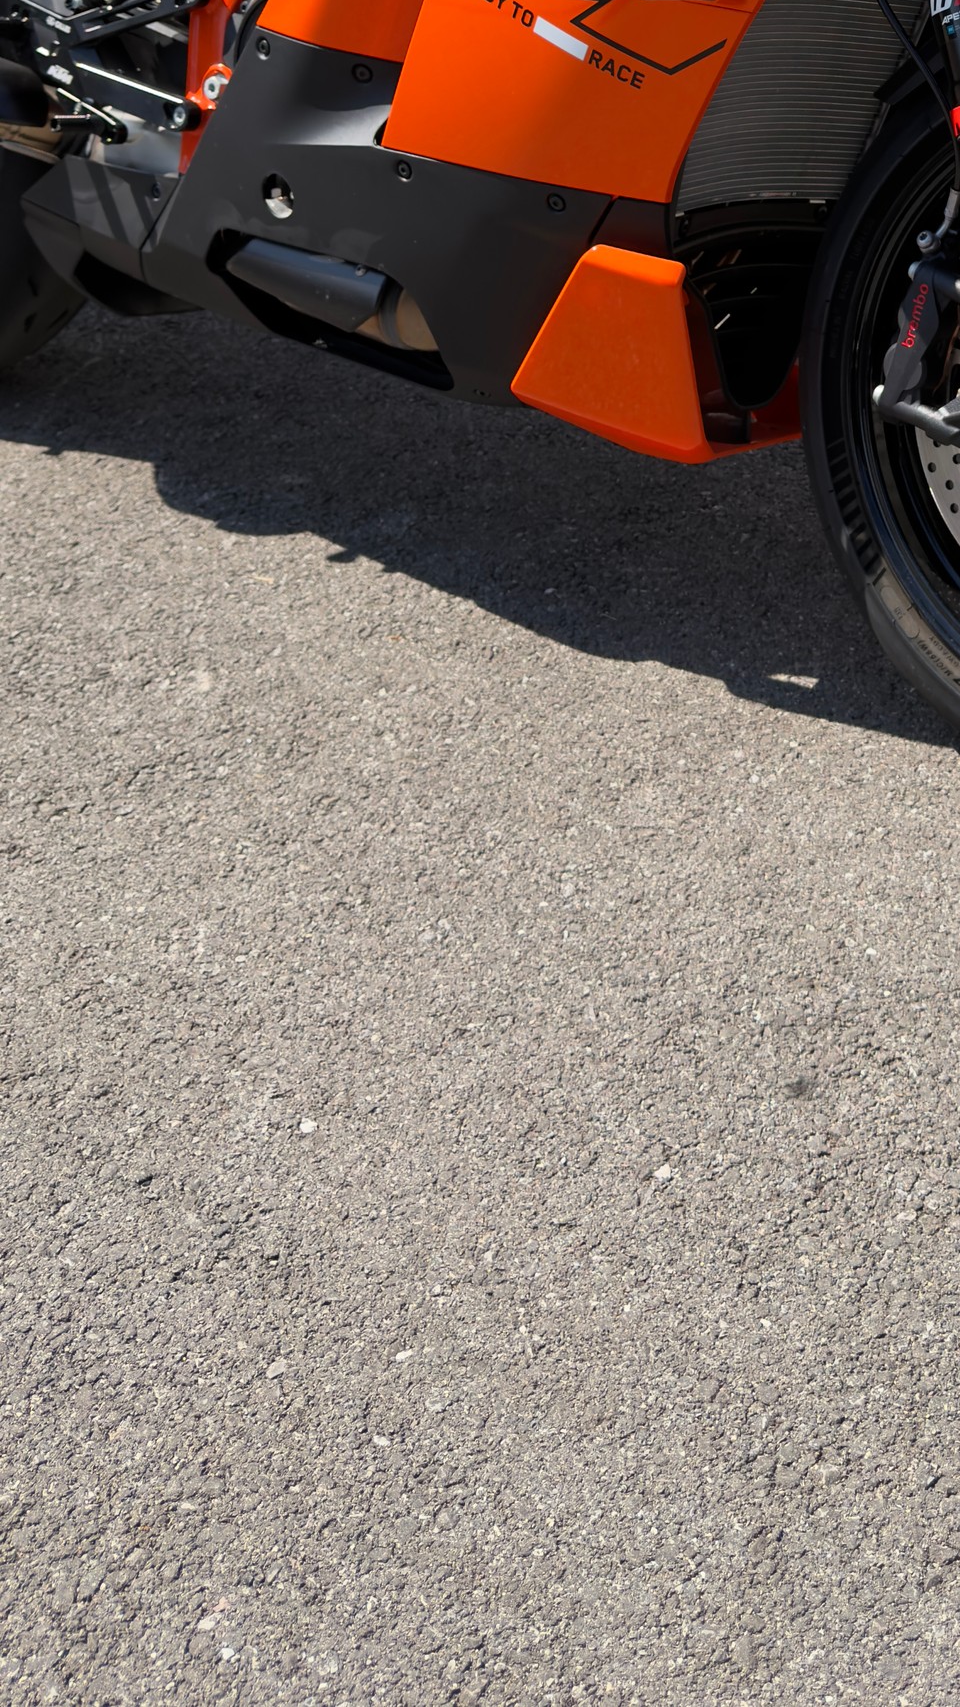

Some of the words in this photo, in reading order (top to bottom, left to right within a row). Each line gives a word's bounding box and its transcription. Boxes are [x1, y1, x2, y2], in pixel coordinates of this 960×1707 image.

[511, 1, 535, 28] TO
[588, 49, 646, 90] RACE
[901, 283, 929, 348] brembo
